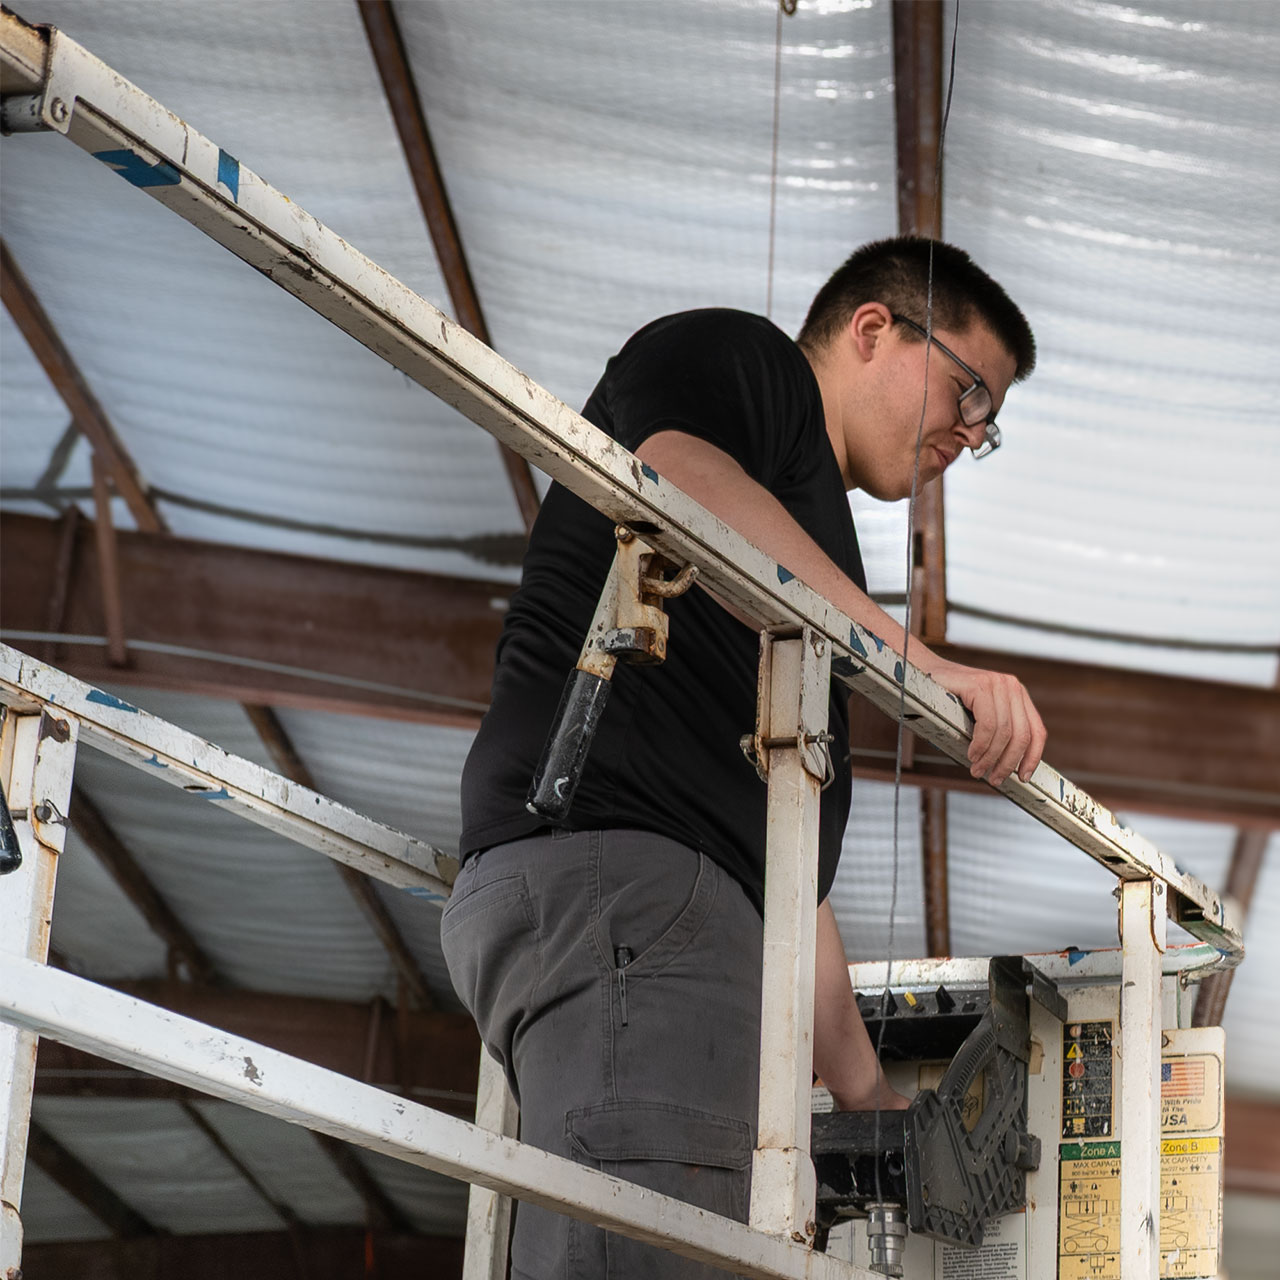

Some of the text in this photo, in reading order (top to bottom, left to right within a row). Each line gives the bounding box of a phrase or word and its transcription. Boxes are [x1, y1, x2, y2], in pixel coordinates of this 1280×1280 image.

[1080, 1145, 1116, 1157] Zone A
[1162, 1141, 1198, 1153] Zone B
[1090, 1160, 1121, 1168] CAPACIT
[1172, 1156, 1208, 1164] CAPACITY
